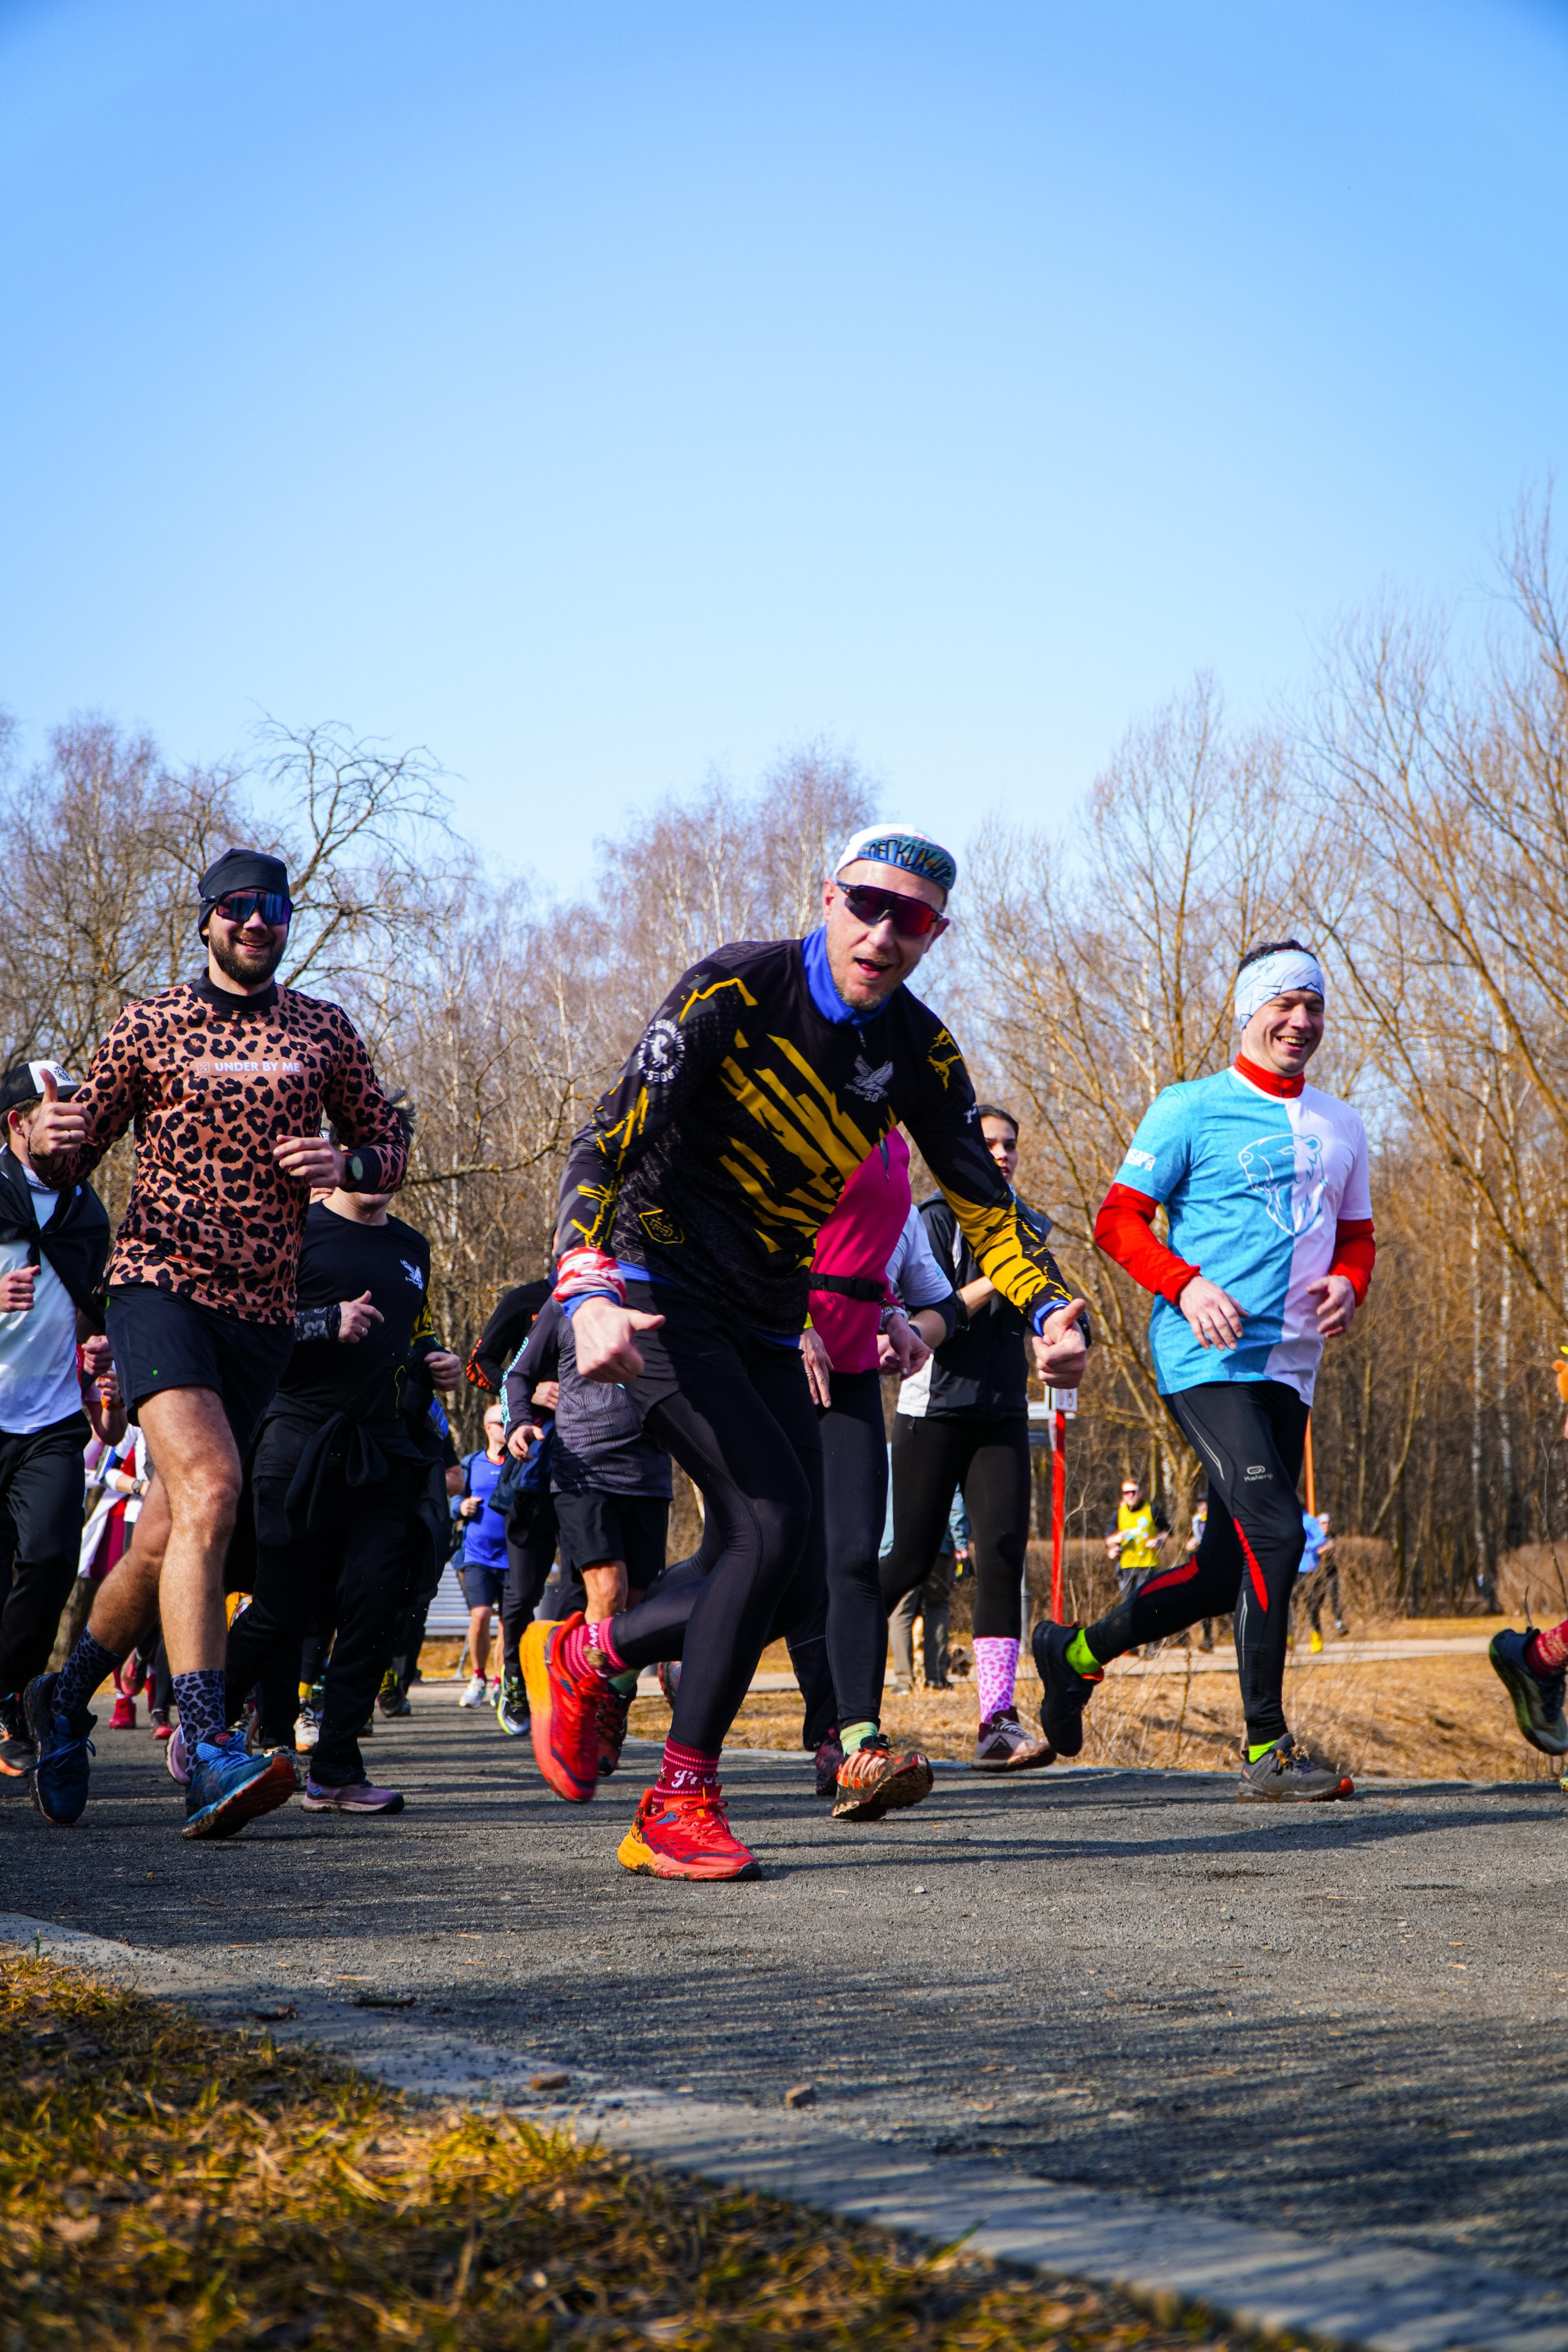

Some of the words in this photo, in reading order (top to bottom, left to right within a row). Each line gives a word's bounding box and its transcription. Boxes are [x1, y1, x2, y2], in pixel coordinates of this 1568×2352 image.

[655, 1019, 685, 1052] RUNNING
[215, 1062, 259, 1071] UNDER
[262, 1061, 278, 1071] BY
[282, 1061, 300, 1072] ME
[647, 1059, 684, 1082] HEROES
[864, 1091, 880, 1102] 50
[1243, 1473, 1273, 1482] Kalenji
